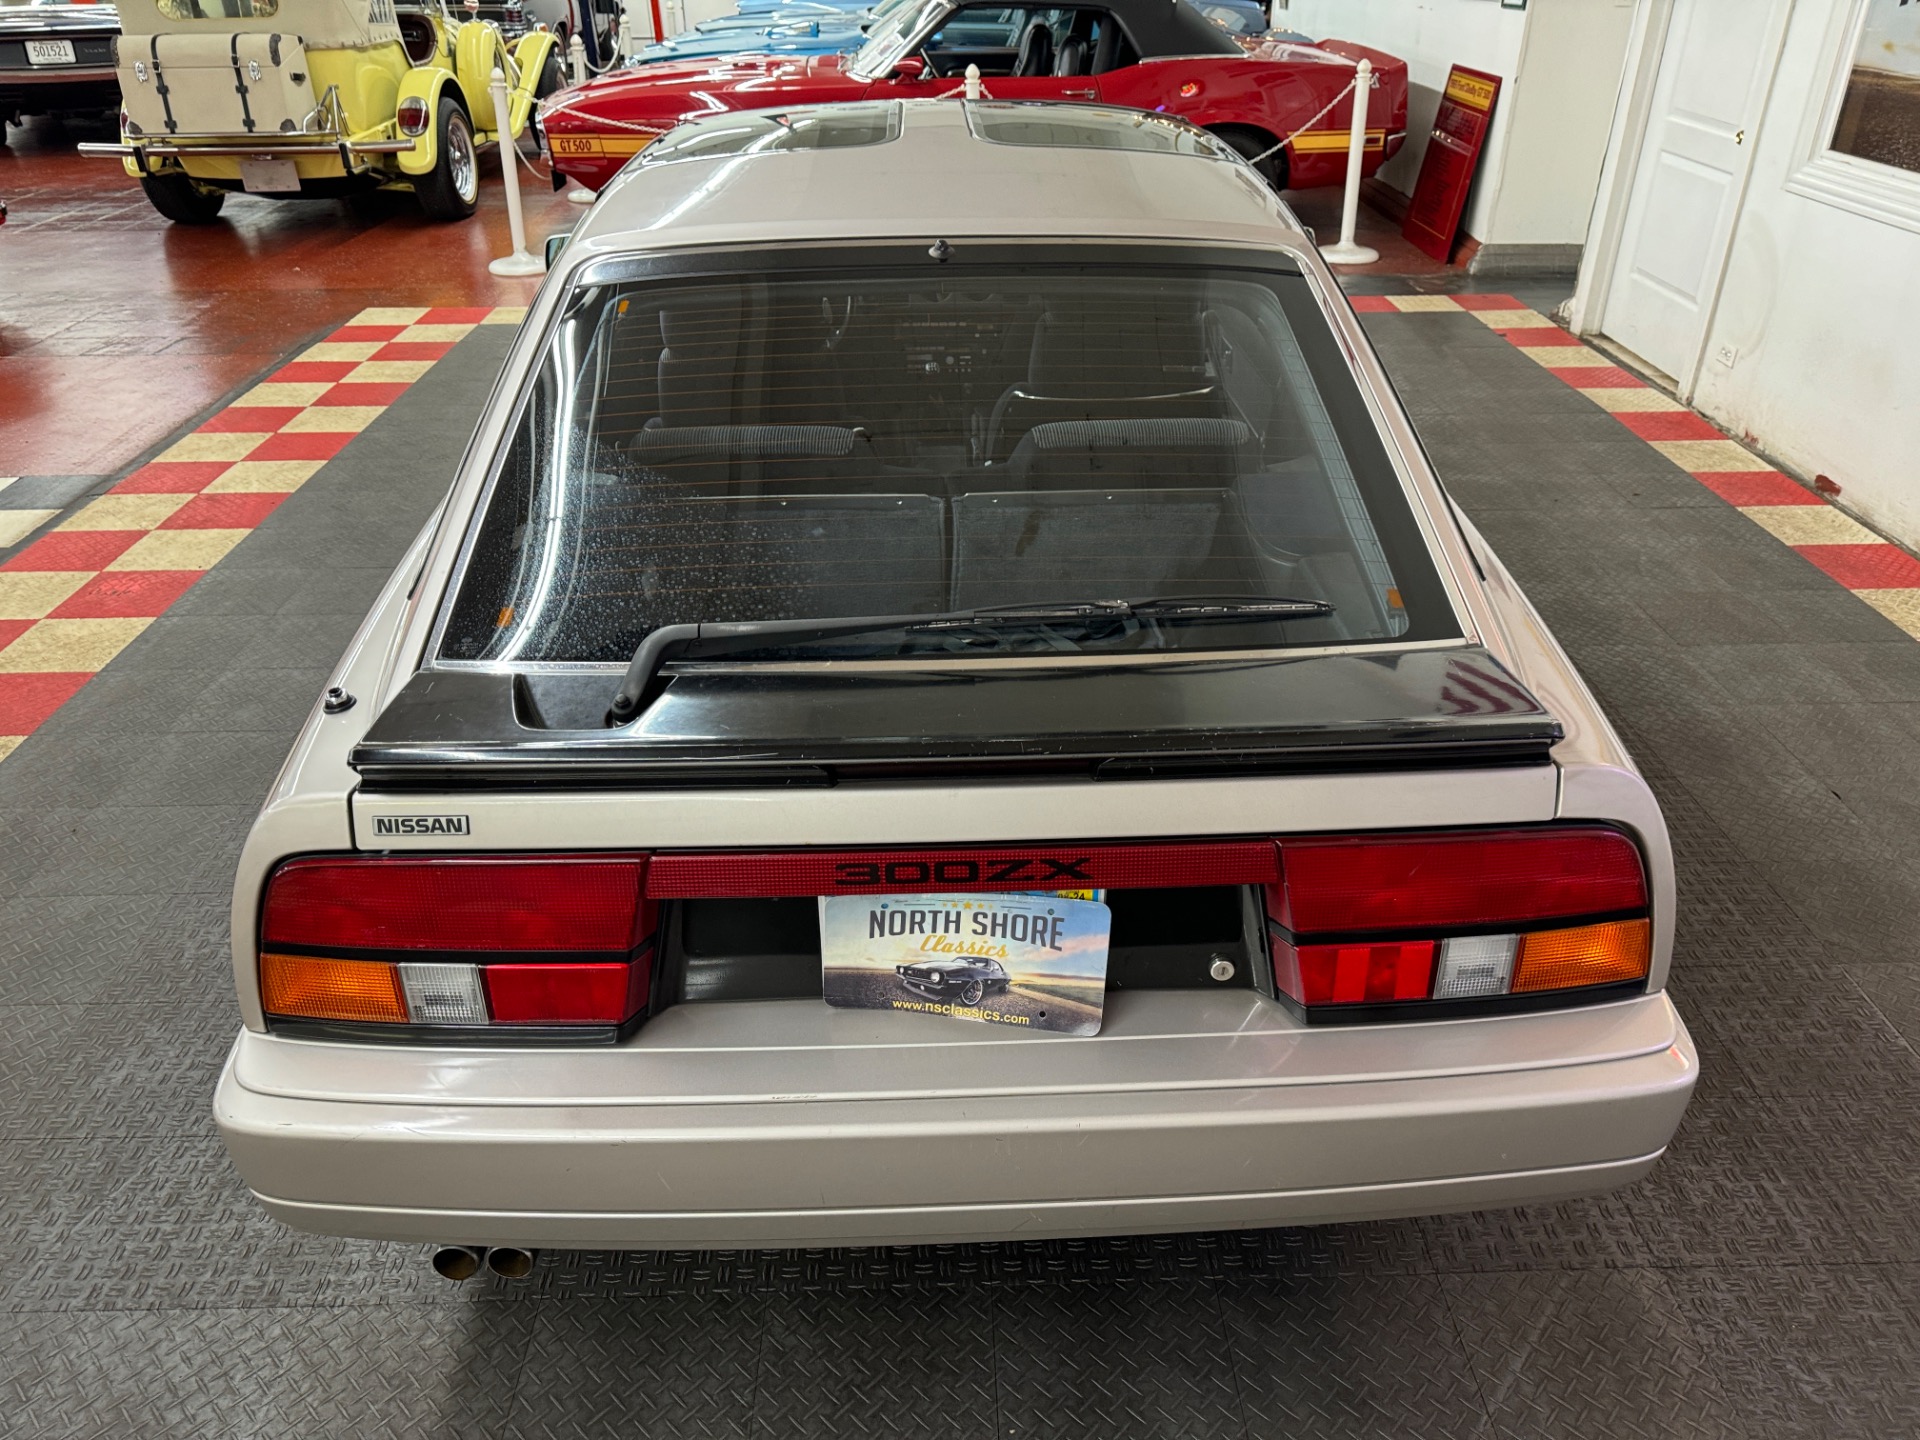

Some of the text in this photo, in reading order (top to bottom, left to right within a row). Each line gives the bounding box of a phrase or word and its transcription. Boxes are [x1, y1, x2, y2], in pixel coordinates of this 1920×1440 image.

[33, 45, 69, 57] 501521
[560, 140, 592, 152] GT 500
[376, 818, 463, 834] NISSAN
[834, 857, 1092, 886] 300ZX
[869, 910, 1064, 951] NORTH SHORE
[920, 934, 1009, 958] Classics
[892, 1000, 1030, 1025] www.nsclassics.com
